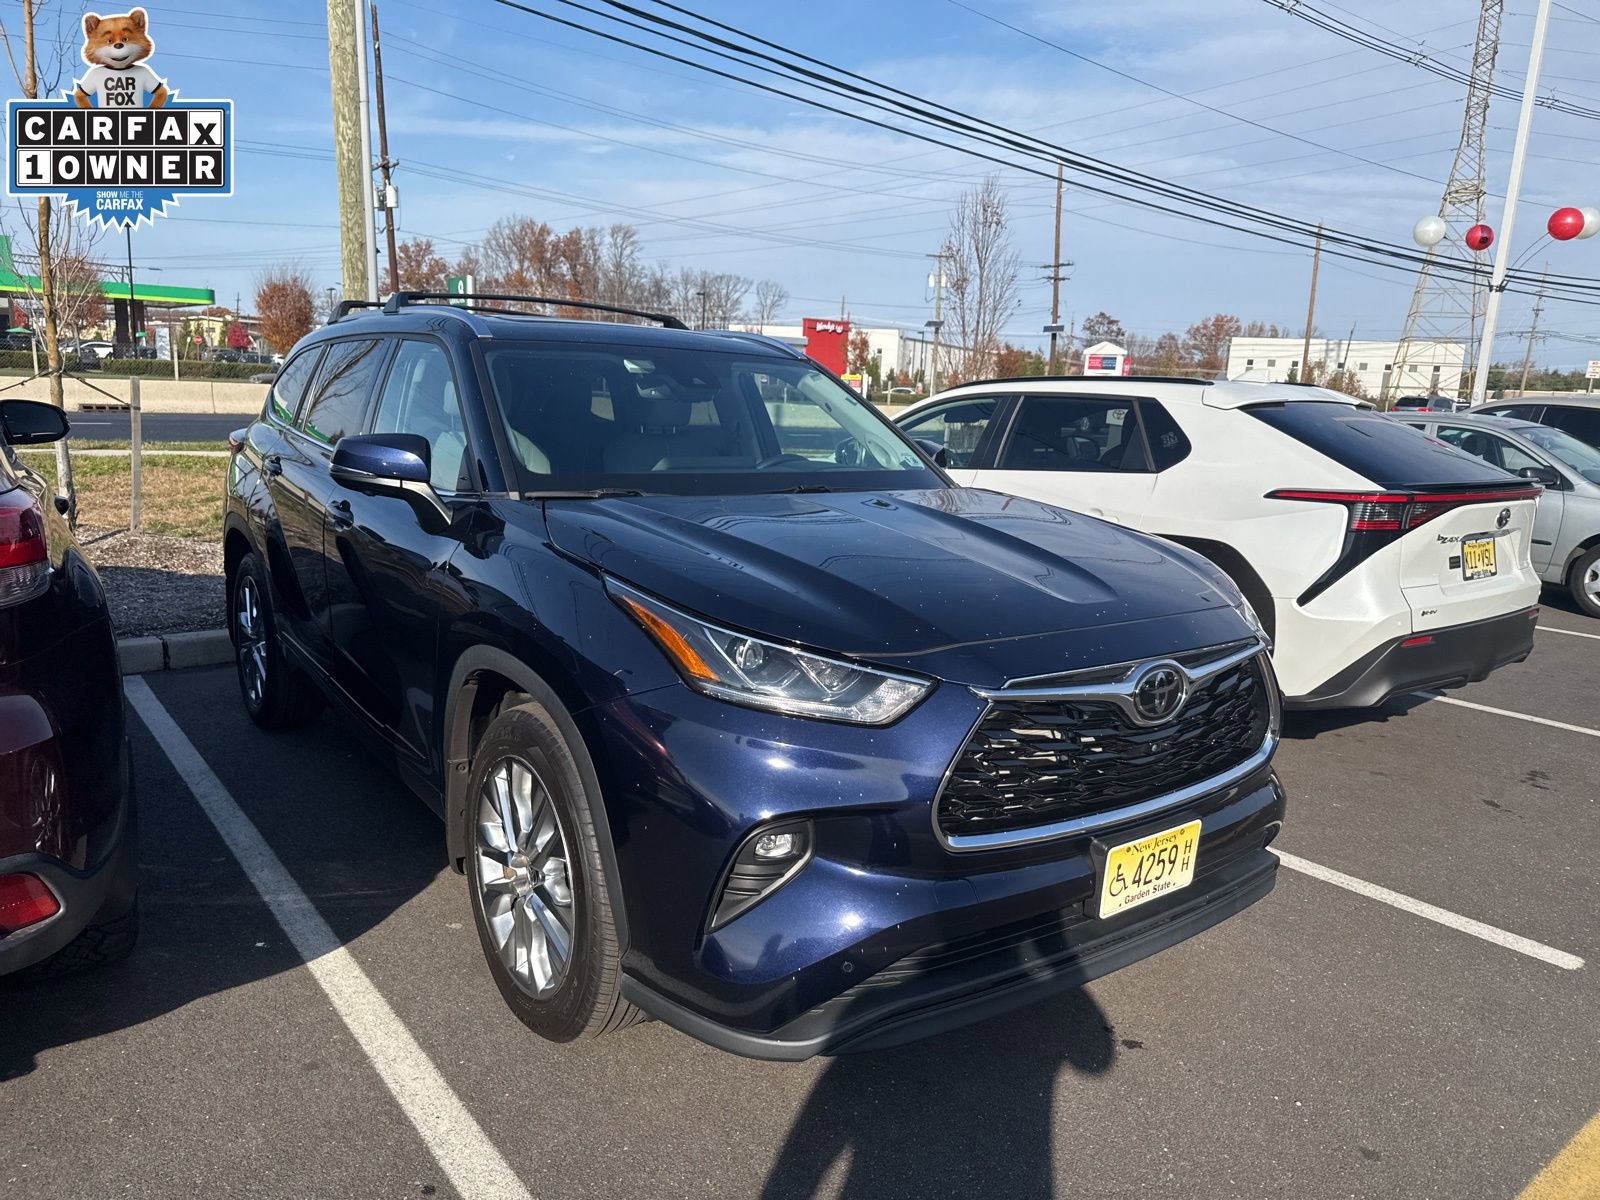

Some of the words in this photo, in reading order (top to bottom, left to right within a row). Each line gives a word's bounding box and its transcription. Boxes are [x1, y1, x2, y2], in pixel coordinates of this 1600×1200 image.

[1131, 841, 1152, 856] New
[1153, 834, 1178, 850] Jersey
[1132, 844, 1179, 888] 4259
[1124, 888, 1150, 905] Garden
[1152, 880, 1171, 894] State
